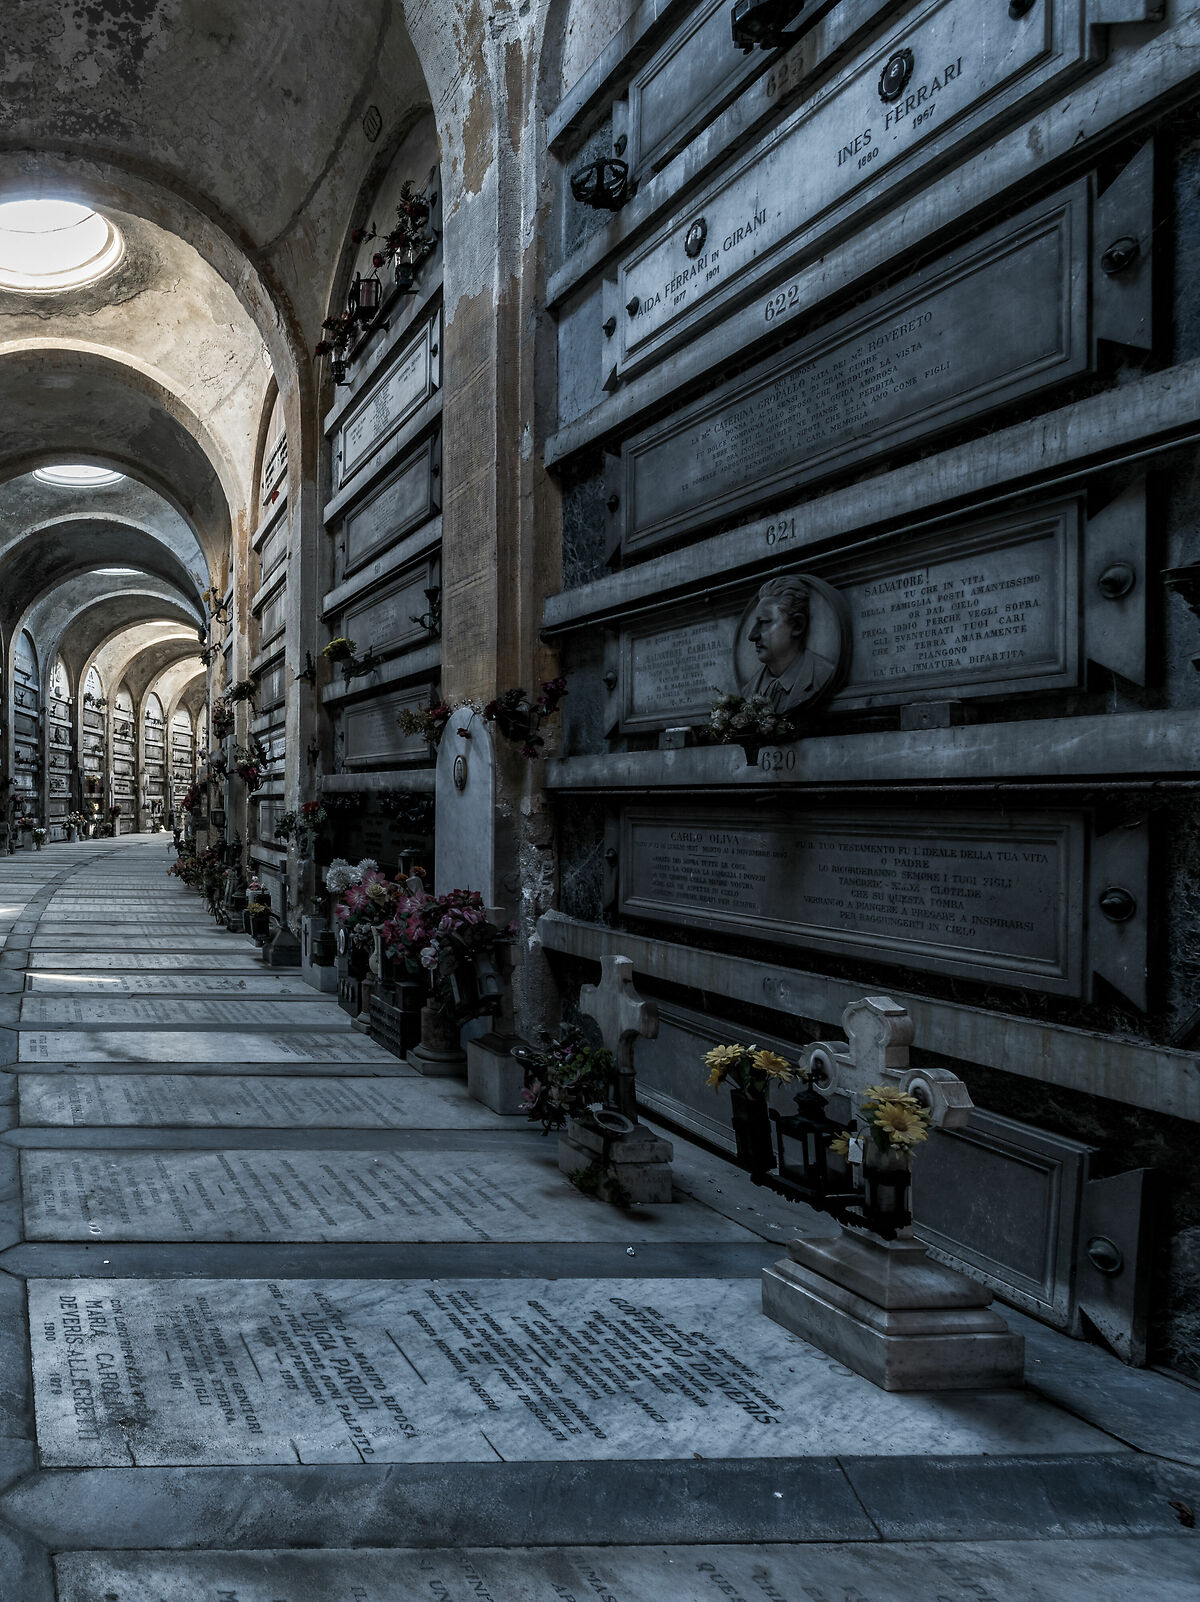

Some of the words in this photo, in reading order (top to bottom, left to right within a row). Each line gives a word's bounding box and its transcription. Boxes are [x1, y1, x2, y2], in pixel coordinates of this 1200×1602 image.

[836, 124, 872, 168] INES
[883, 54, 963, 133] FERRARI
[856, 144, 879, 171] 1880
[636, 288, 660, 320] AIDA
[664, 252, 708, 299] FERRARI
[722, 205, 767, 254] GIRANI
[673, 288, 686, 307] 1877
[705, 262, 720, 283] 1901
[765, 284, 799, 321] 622
[766, 518, 798, 545] 621
[761, 751, 795, 772] 620
[58, 1295, 83, 1344] DEVERIS
[83, 1299, 110, 1337] MARIA
[298, 1311, 342, 1352] LUIGIA
[326, 1357, 379, 1411] PARODI
[604, 1297, 697, 1357] GOFFREDO
[685, 1362, 782, 1424] DEVERIS
